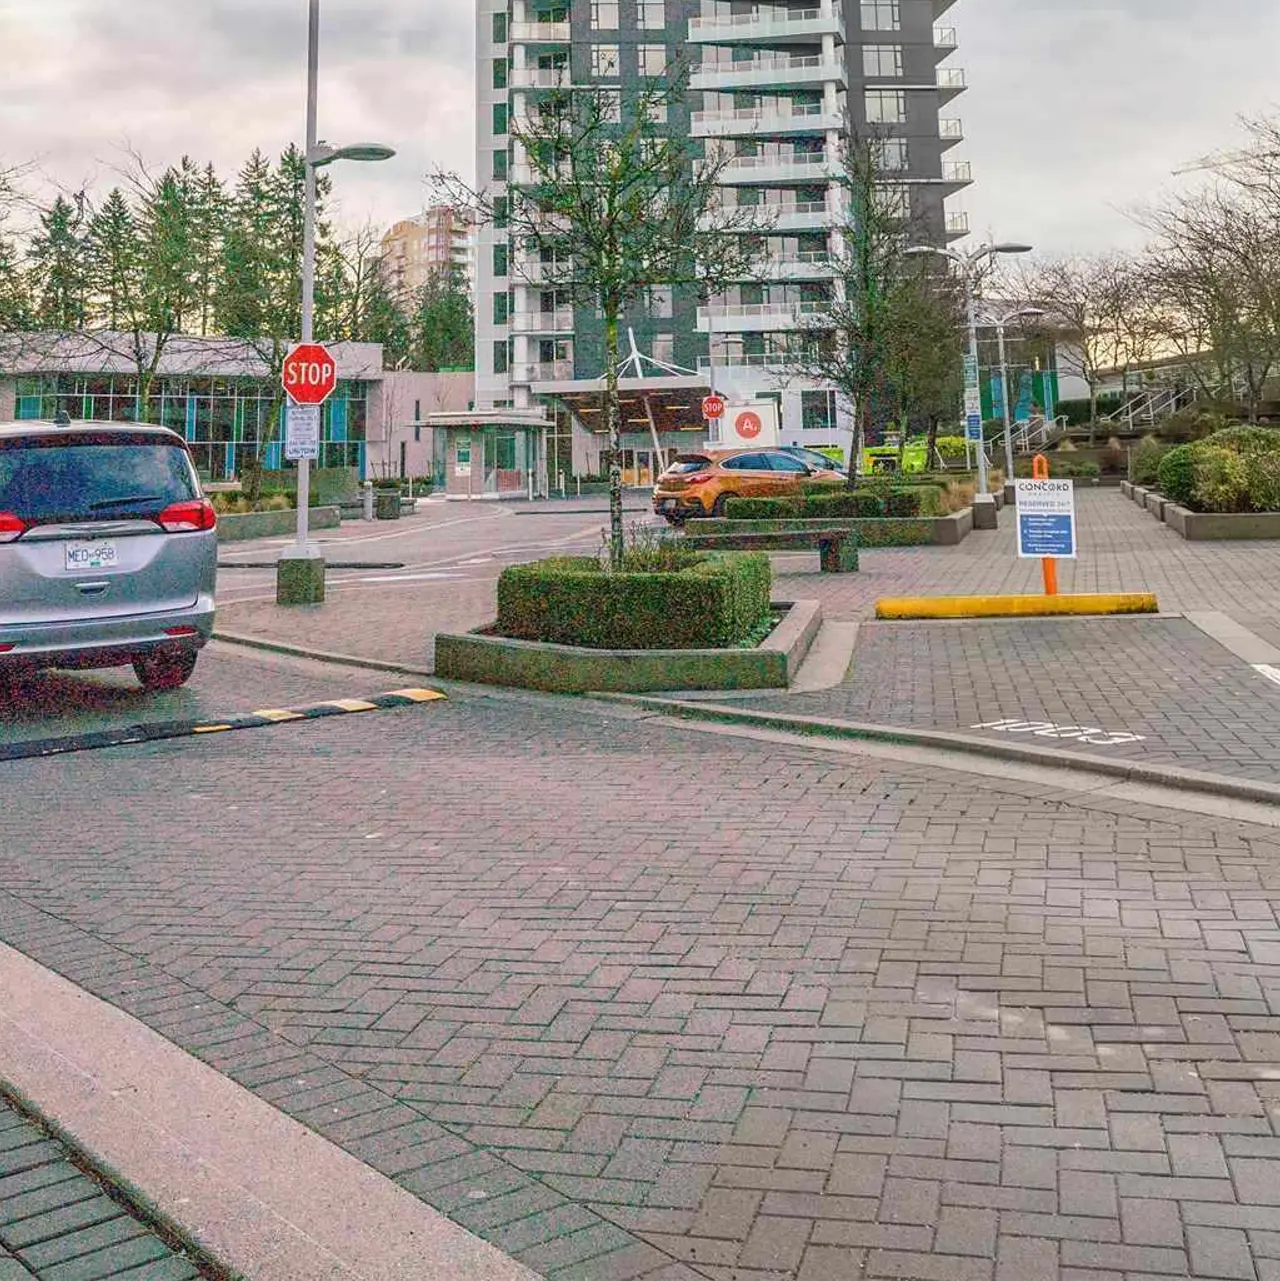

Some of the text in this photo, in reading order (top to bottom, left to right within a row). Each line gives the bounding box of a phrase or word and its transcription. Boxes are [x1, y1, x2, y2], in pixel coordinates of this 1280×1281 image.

[287, 362, 332, 386] STOP
[704, 402, 723, 413] STOP
[1019, 482, 1070, 491] CONCORD
[970, 719, 1147, 744] 1003
